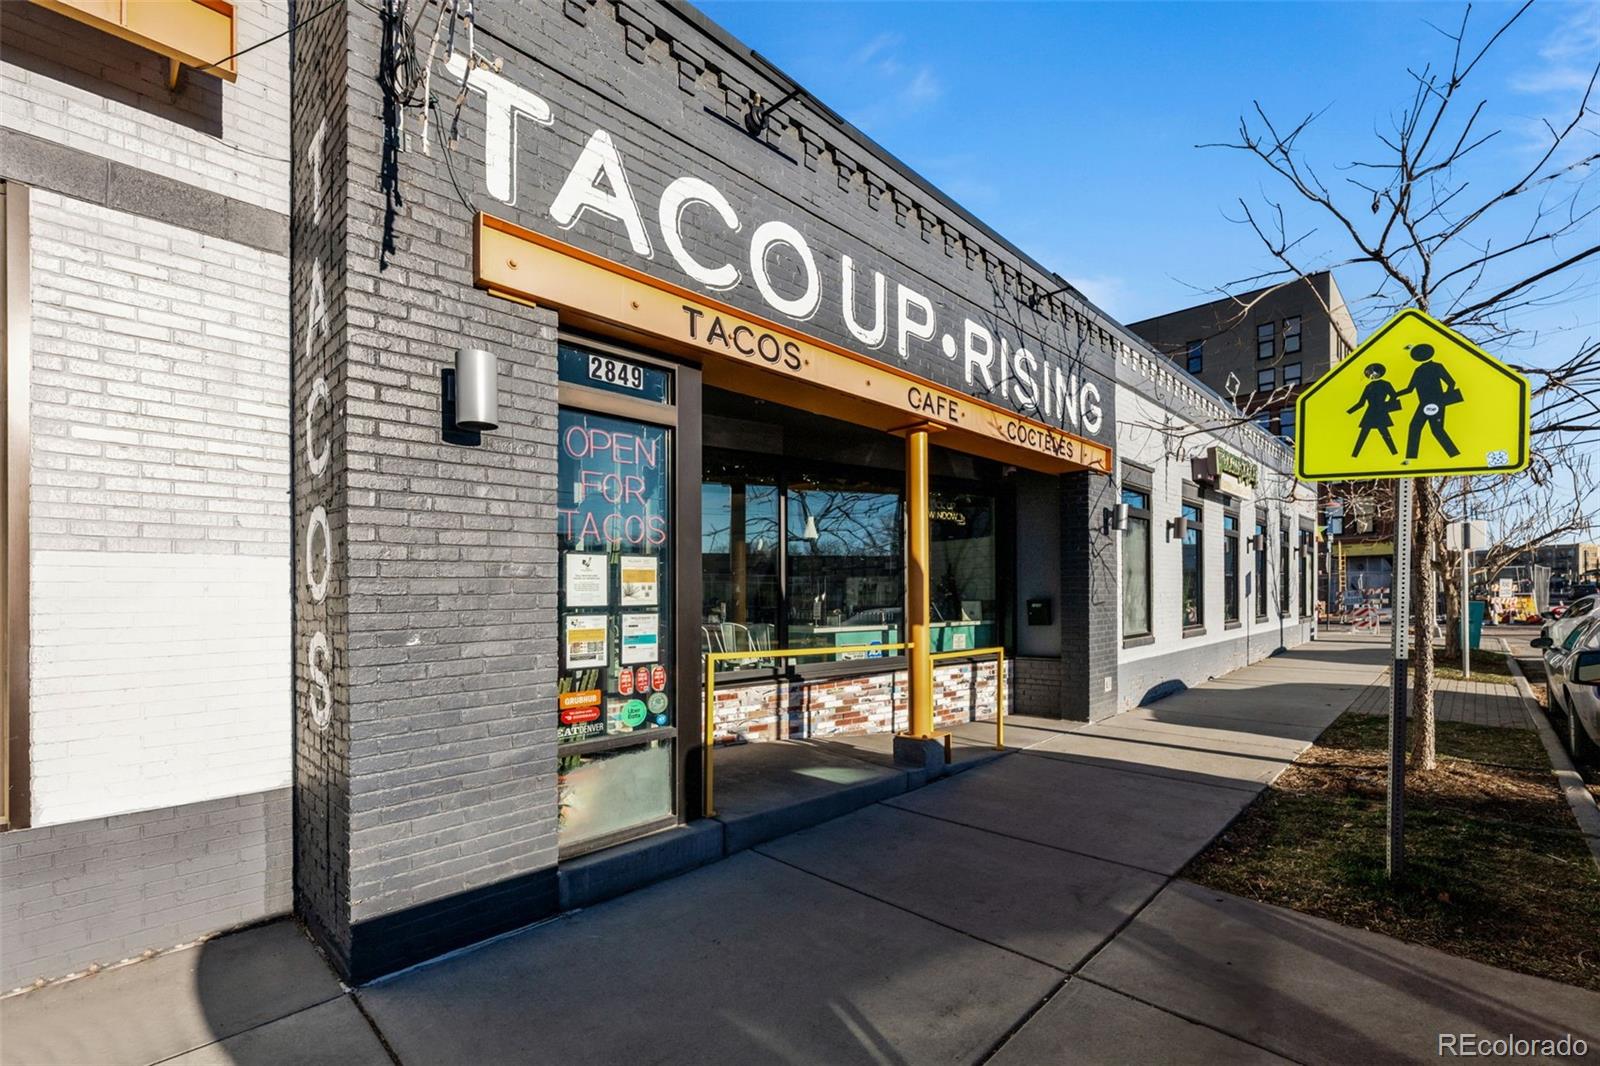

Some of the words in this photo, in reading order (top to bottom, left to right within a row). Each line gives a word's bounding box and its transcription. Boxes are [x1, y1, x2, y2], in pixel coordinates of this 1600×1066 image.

[444, 51, 822, 321] TACO
[681, 305, 802, 371] TACOS
[590, 356, 643, 389] 2849
[907, 387, 959, 423] CAFE
[306, 117, 332, 731] TACOS
[565, 426, 656, 467] OPEN
[581, 470, 648, 505] FOR
[558, 509, 665, 544] TACOS
[564, 694, 597, 705] GRUBHUB
